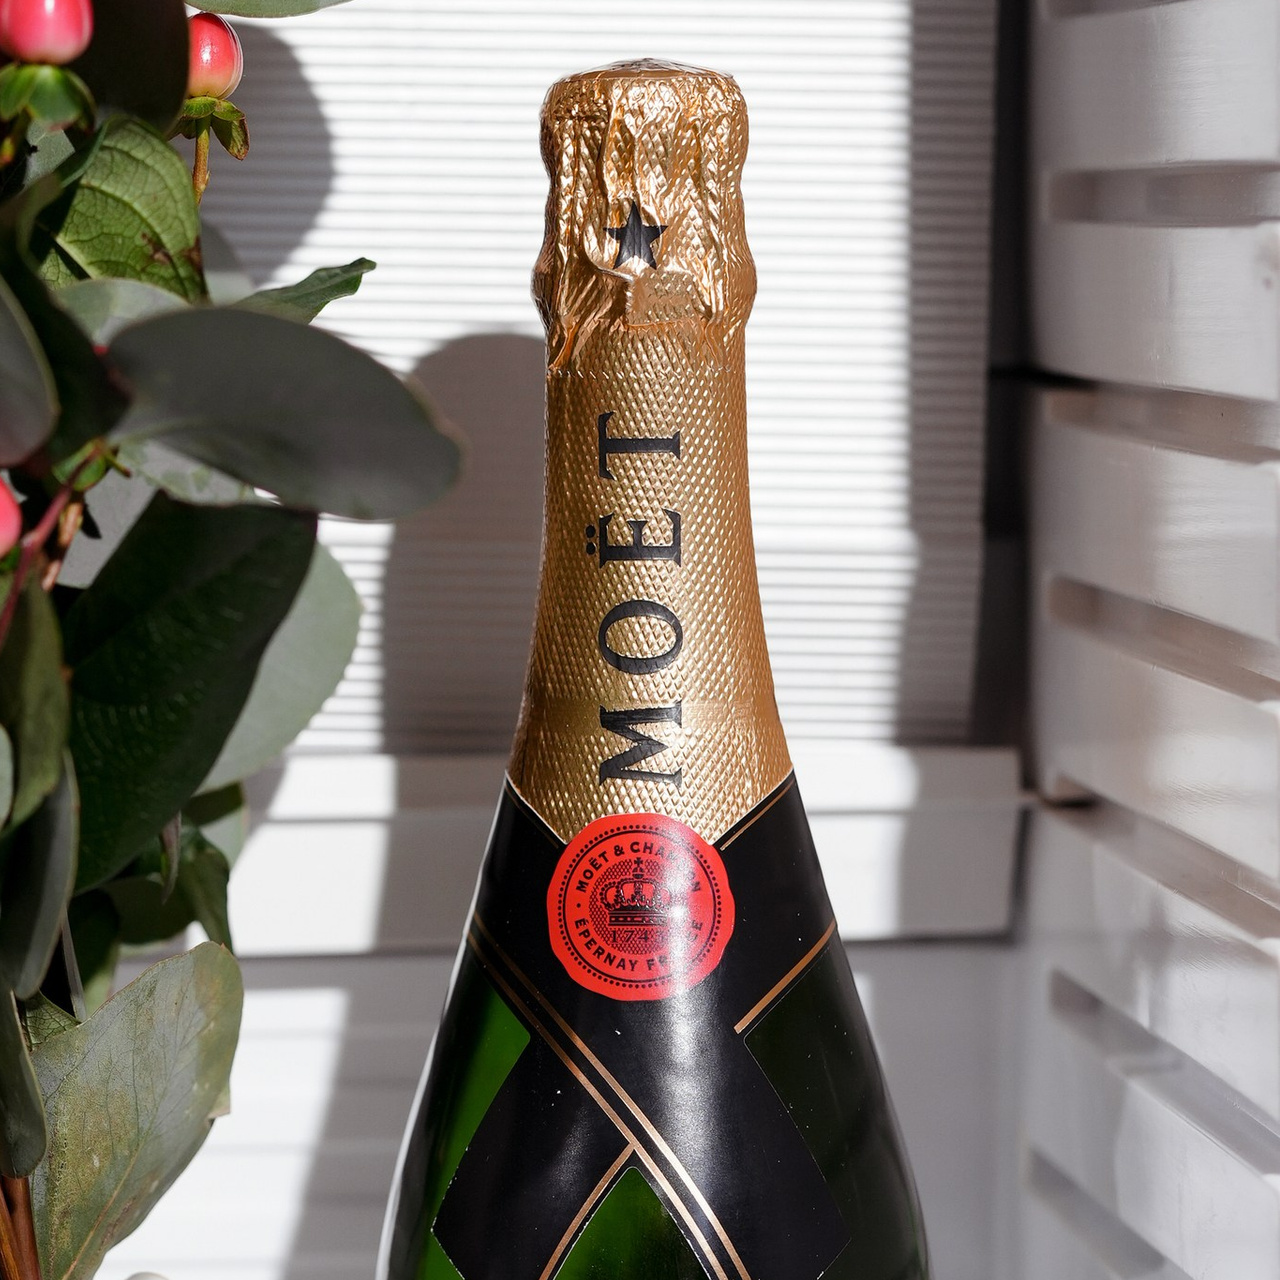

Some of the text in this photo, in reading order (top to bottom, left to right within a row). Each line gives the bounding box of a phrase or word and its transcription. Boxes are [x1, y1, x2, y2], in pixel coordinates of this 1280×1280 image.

[585, 411, 683, 788] MOËT
[576, 851, 610, 893] MOËT
[613, 844, 624, 857] &
[575, 917, 703, 971] ÉPERNAY FRCE
